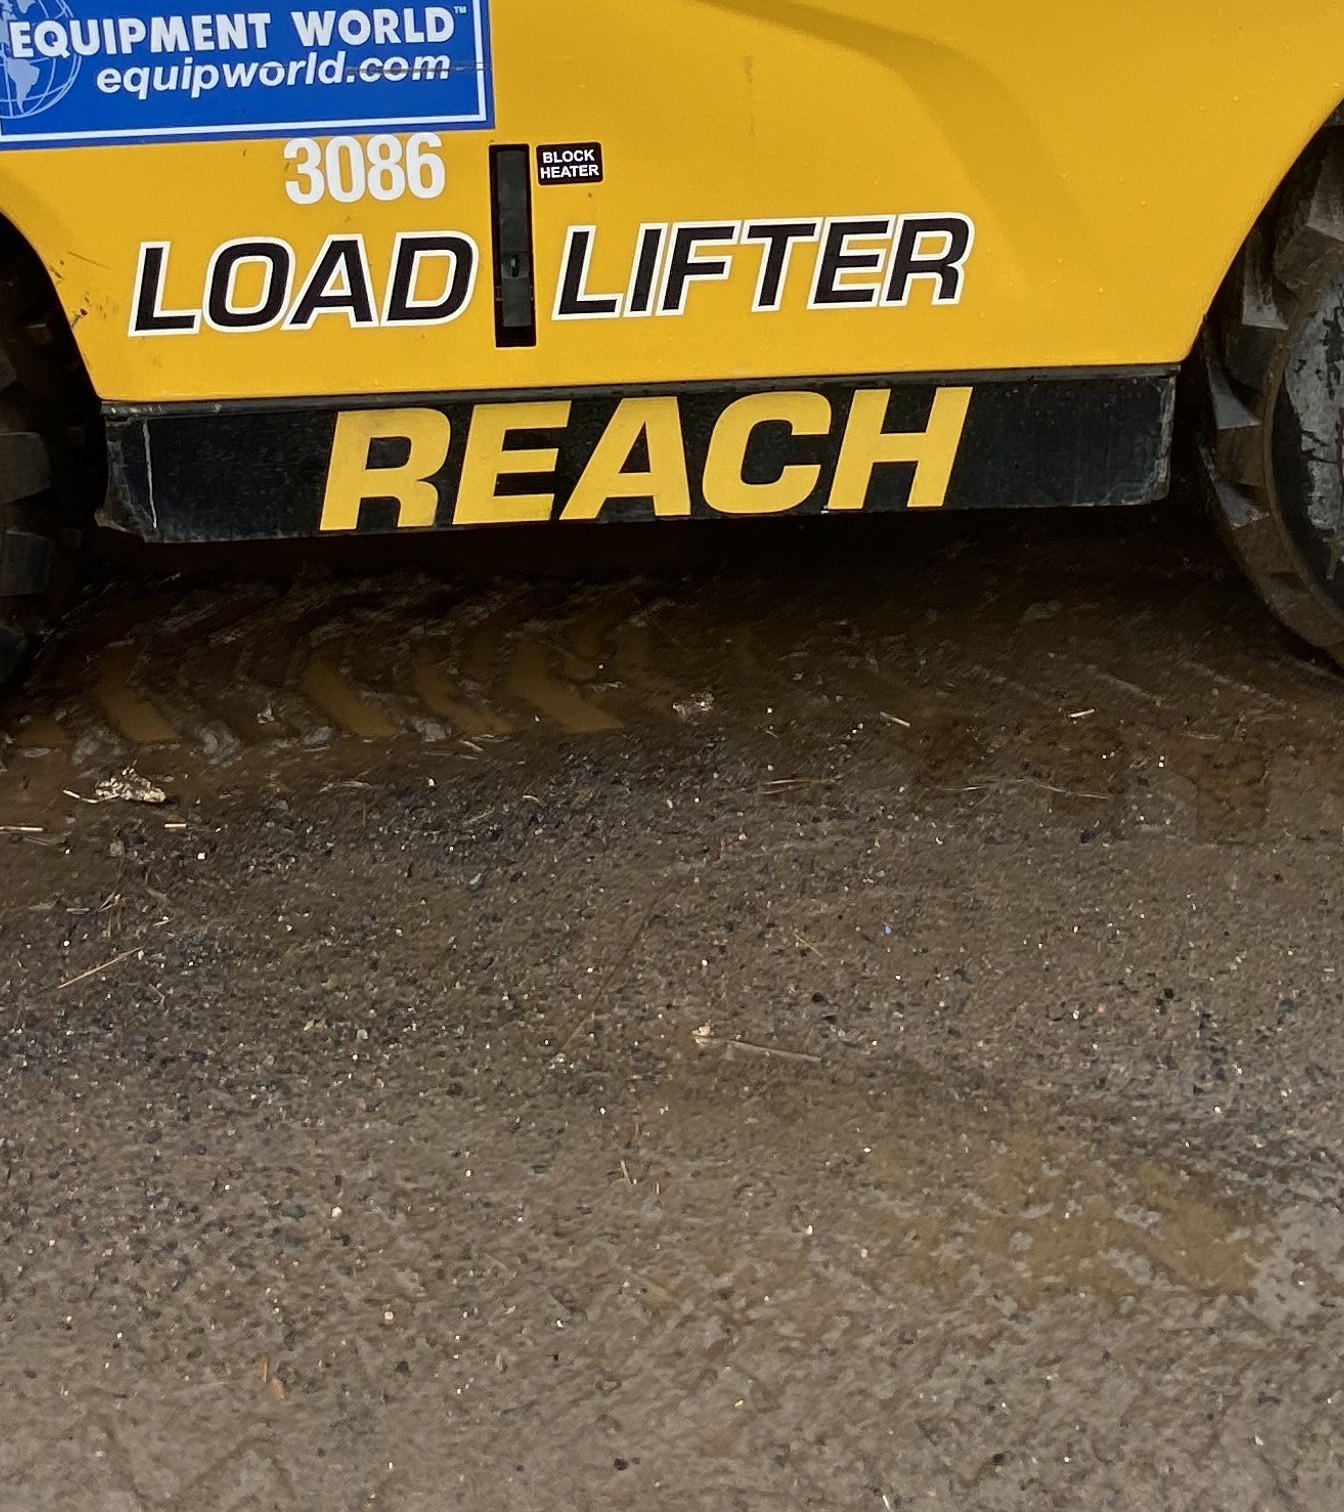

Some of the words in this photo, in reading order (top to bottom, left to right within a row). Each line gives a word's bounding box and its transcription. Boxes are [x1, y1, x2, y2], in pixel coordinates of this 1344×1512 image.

[7, 11, 272, 60] EQUIPMENT
[96, 51, 452, 99] equipworld.com
[282, 132, 447, 206] 3086
[540, 164, 600, 180] HEATER
[542, 148, 596, 164] BLOCK
[127, 230, 480, 339] LOAD
[550, 211, 976, 322] LIFTER
[319, 386, 974, 533] REACH
